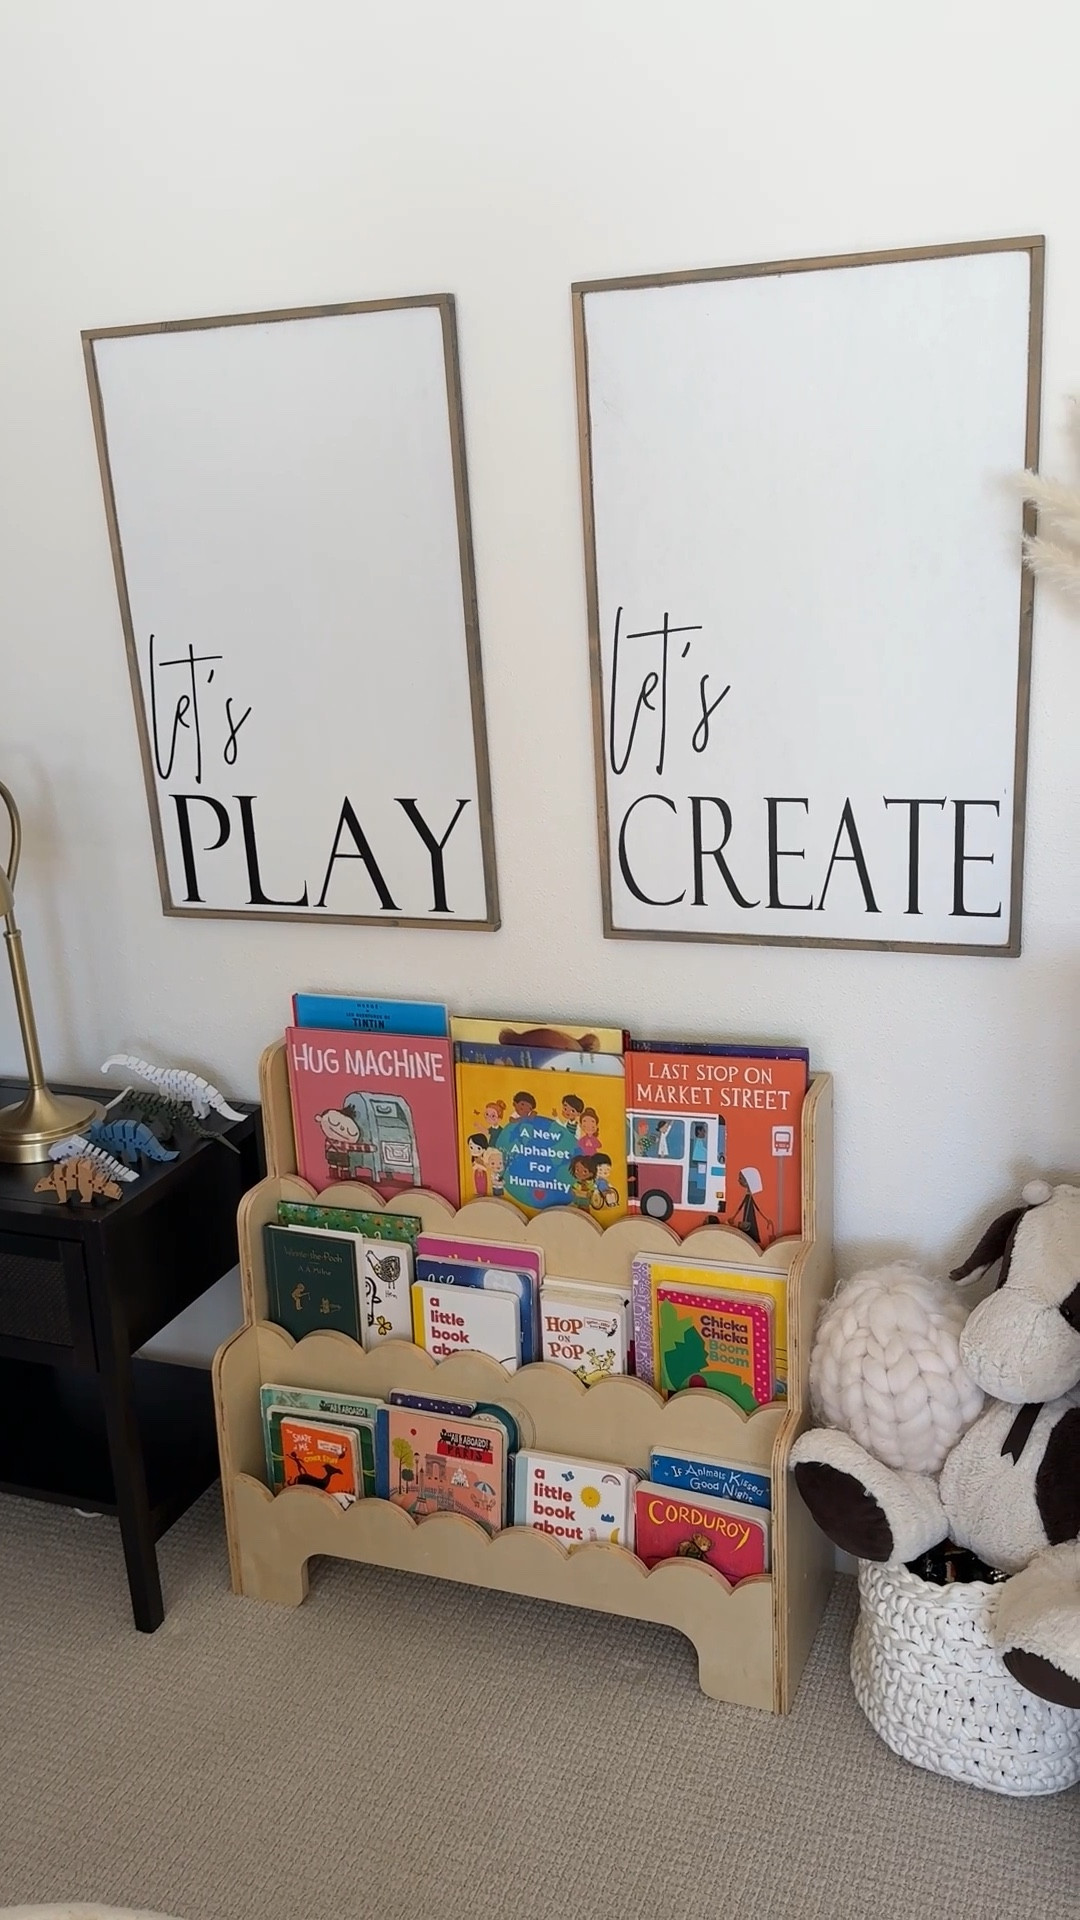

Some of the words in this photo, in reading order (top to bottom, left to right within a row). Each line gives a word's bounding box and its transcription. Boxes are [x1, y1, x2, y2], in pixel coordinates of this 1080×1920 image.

[168, 794, 472, 913] PLAY
[618, 794, 1001, 918] CREATE
[352, 1018, 385, 1029] TINTIN
[292, 1043, 339, 1074] HUG
[345, 1048, 445, 1082] MACHINE
[649, 1062, 689, 1081] LAST
[696, 1064, 739, 1083] STOP
[744, 1067, 773, 1085] ON
[636, 1083, 713, 1105] MARKET
[720, 1087, 791, 1111] STREET
[520, 1127, 530, 1138] A
[533, 1129, 561, 1141] New
[510, 1144, 570, 1160] Alphabet
[529, 1162, 552, 1174] For
[509, 1175, 571, 1194] Humanity
[430, 1297, 440, 1307] a
[430, 1310, 465, 1327] little
[545, 1316, 583, 1335] HOP
[700, 1315, 748, 1334] Chicka
[431, 1326, 470, 1344] book
[557, 1335, 571, 1343] ON
[700, 1327, 748, 1345] Chicka
[548, 1342, 585, 1361] POP
[708, 1339, 749, 1356] Boom
[708, 1351, 749, 1368] Boom
[448, 1446, 482, 1461] PARIS
[534, 1468, 545, 1479] a
[533, 1482, 573, 1502] little
[689, 1477, 719, 1490] Good
[729, 1471, 764, 1497] Kissed
[533, 1500, 576, 1521] book
[533, 1520, 583, 1540] about
[648, 1500, 751, 1553] CORDUROY
